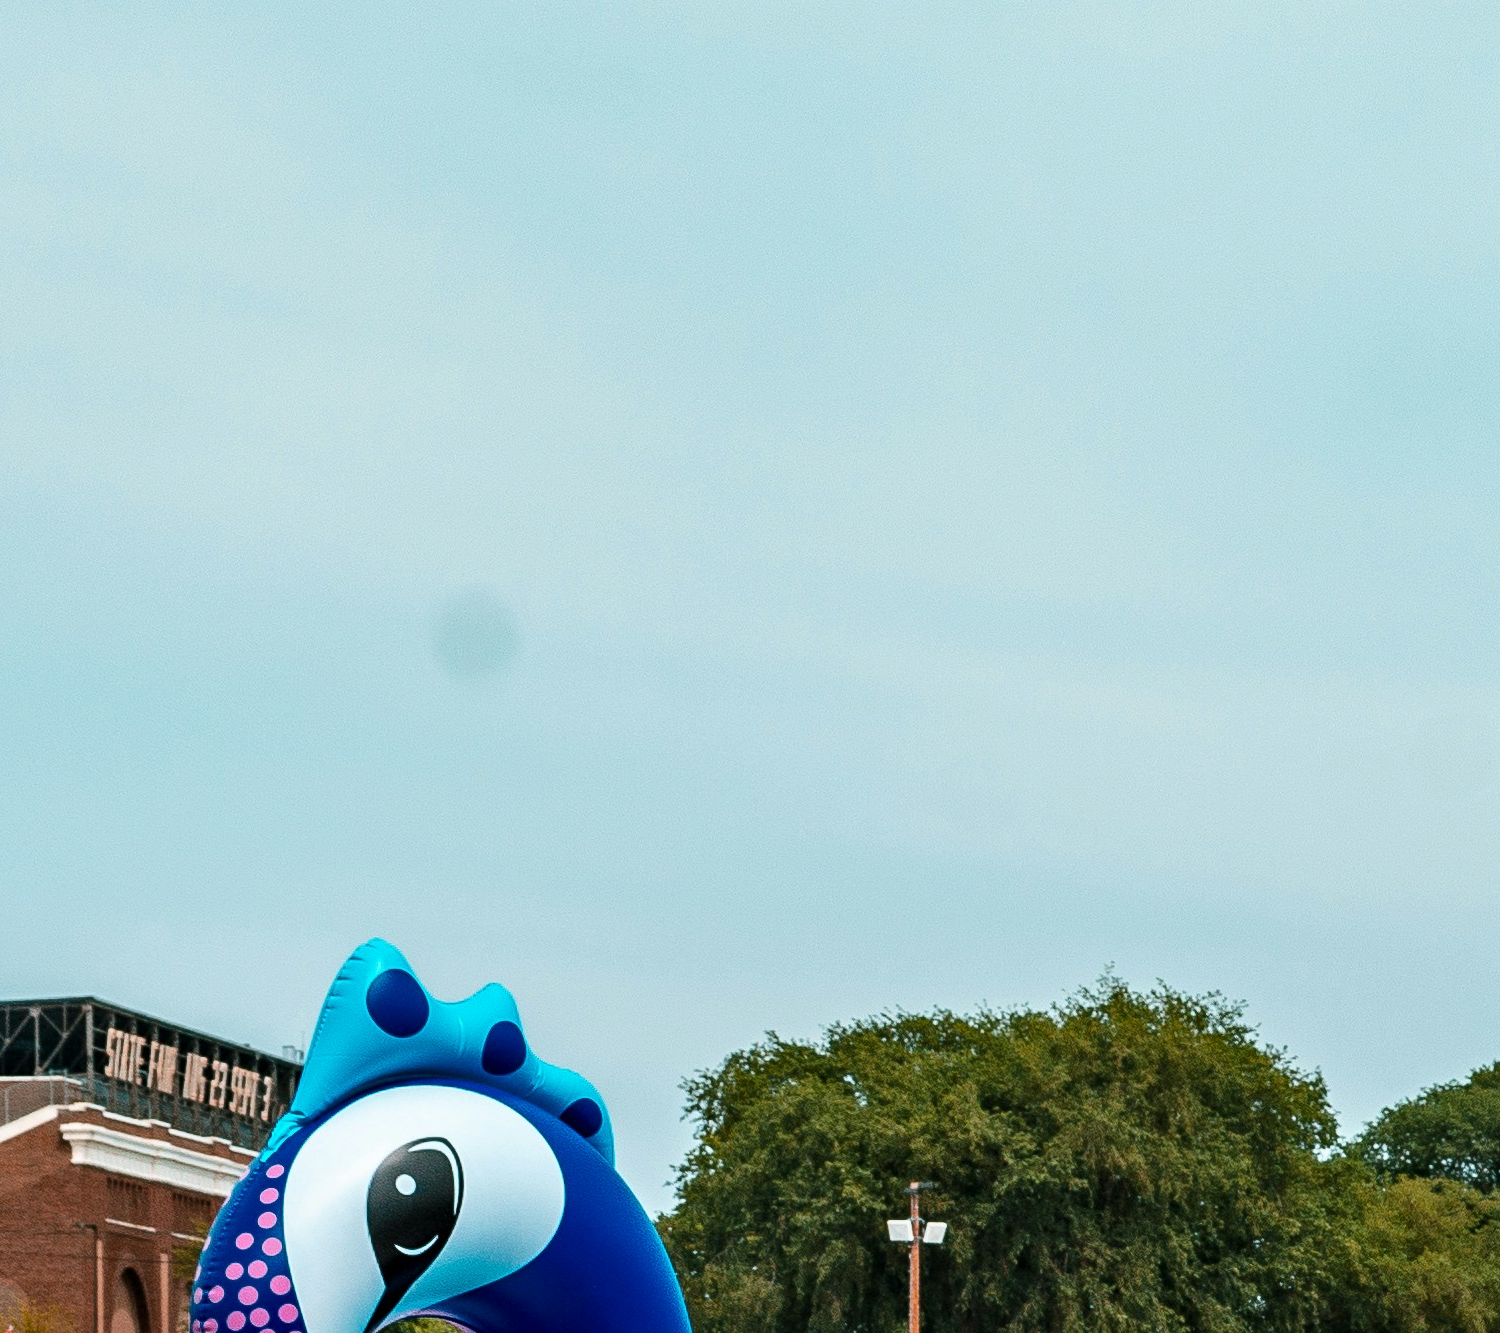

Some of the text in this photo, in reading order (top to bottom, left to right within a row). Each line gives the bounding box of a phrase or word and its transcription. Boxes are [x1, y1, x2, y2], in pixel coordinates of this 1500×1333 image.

[104, 1027, 146, 1086] STATE
[147, 1040, 178, 1095] FAIR
[229, 1066, 260, 1118] SEPT
[261, 1076, 273, 1122] 3
